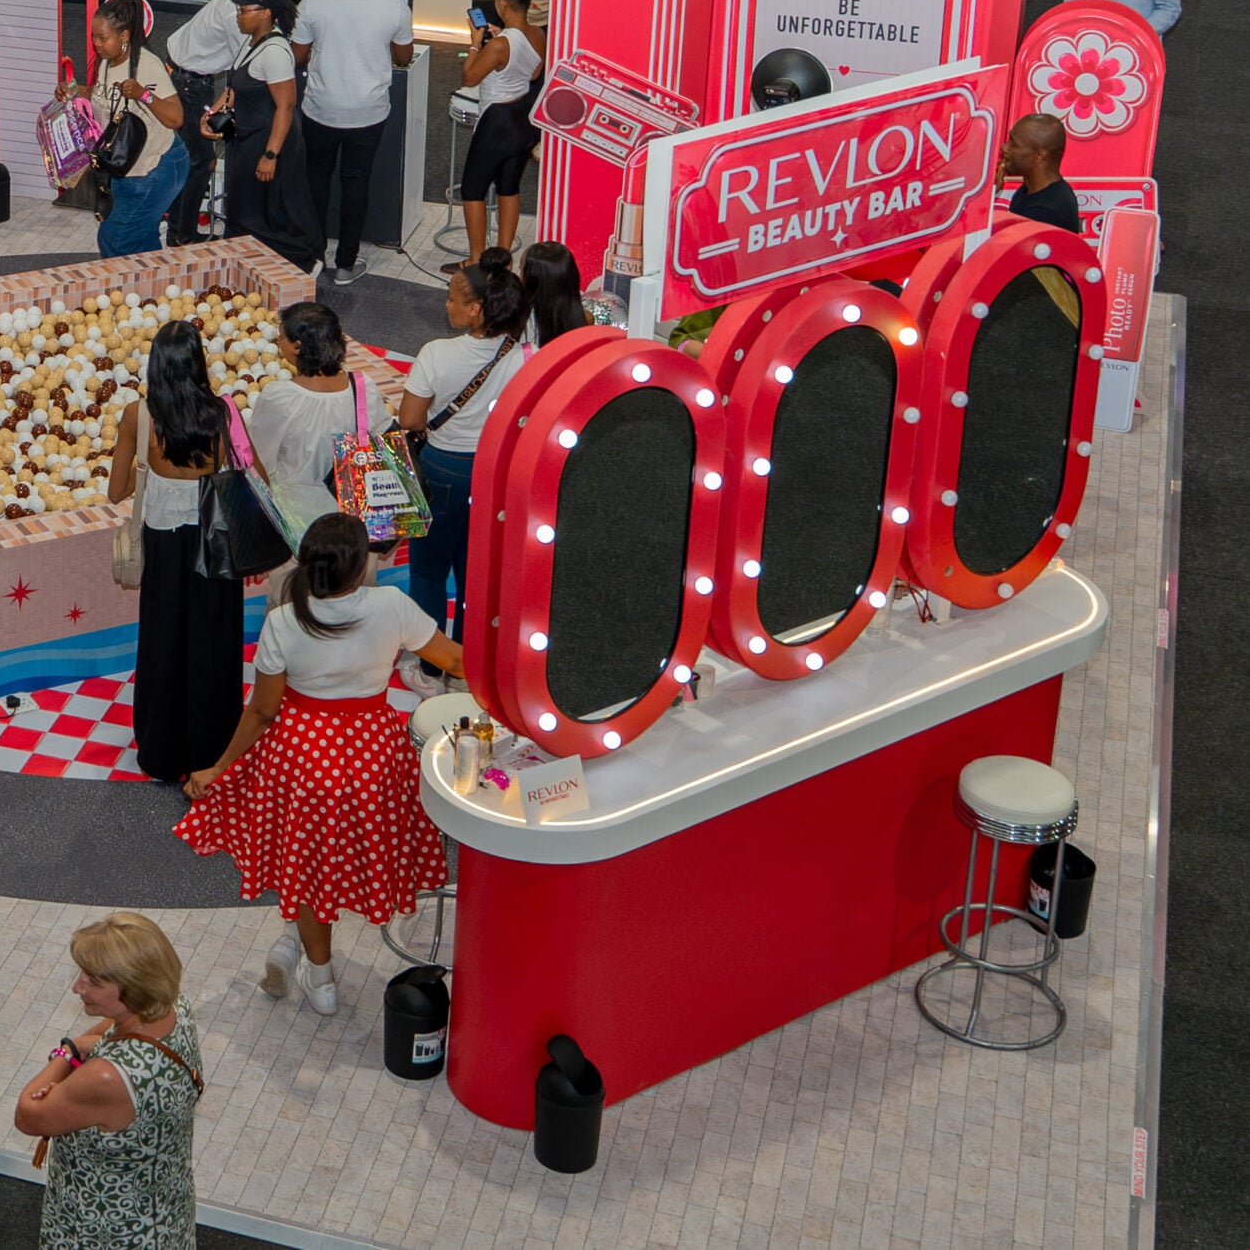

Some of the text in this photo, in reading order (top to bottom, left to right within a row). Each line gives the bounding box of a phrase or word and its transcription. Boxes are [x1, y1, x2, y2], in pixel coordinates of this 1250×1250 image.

[777, 15, 920, 44] UNFORGETTABLE
[717, 112, 955, 224] REVLON
[747, 181, 924, 254] BEAUTY BAR
[612, 259, 643, 273] REVL
[1103, 297, 1127, 352] Photo
[1100, 361, 1129, 372] EVLON
[527, 778, 579, 802] REVLON
[1133, 1128, 1146, 1196] MIND YOUR STEP
